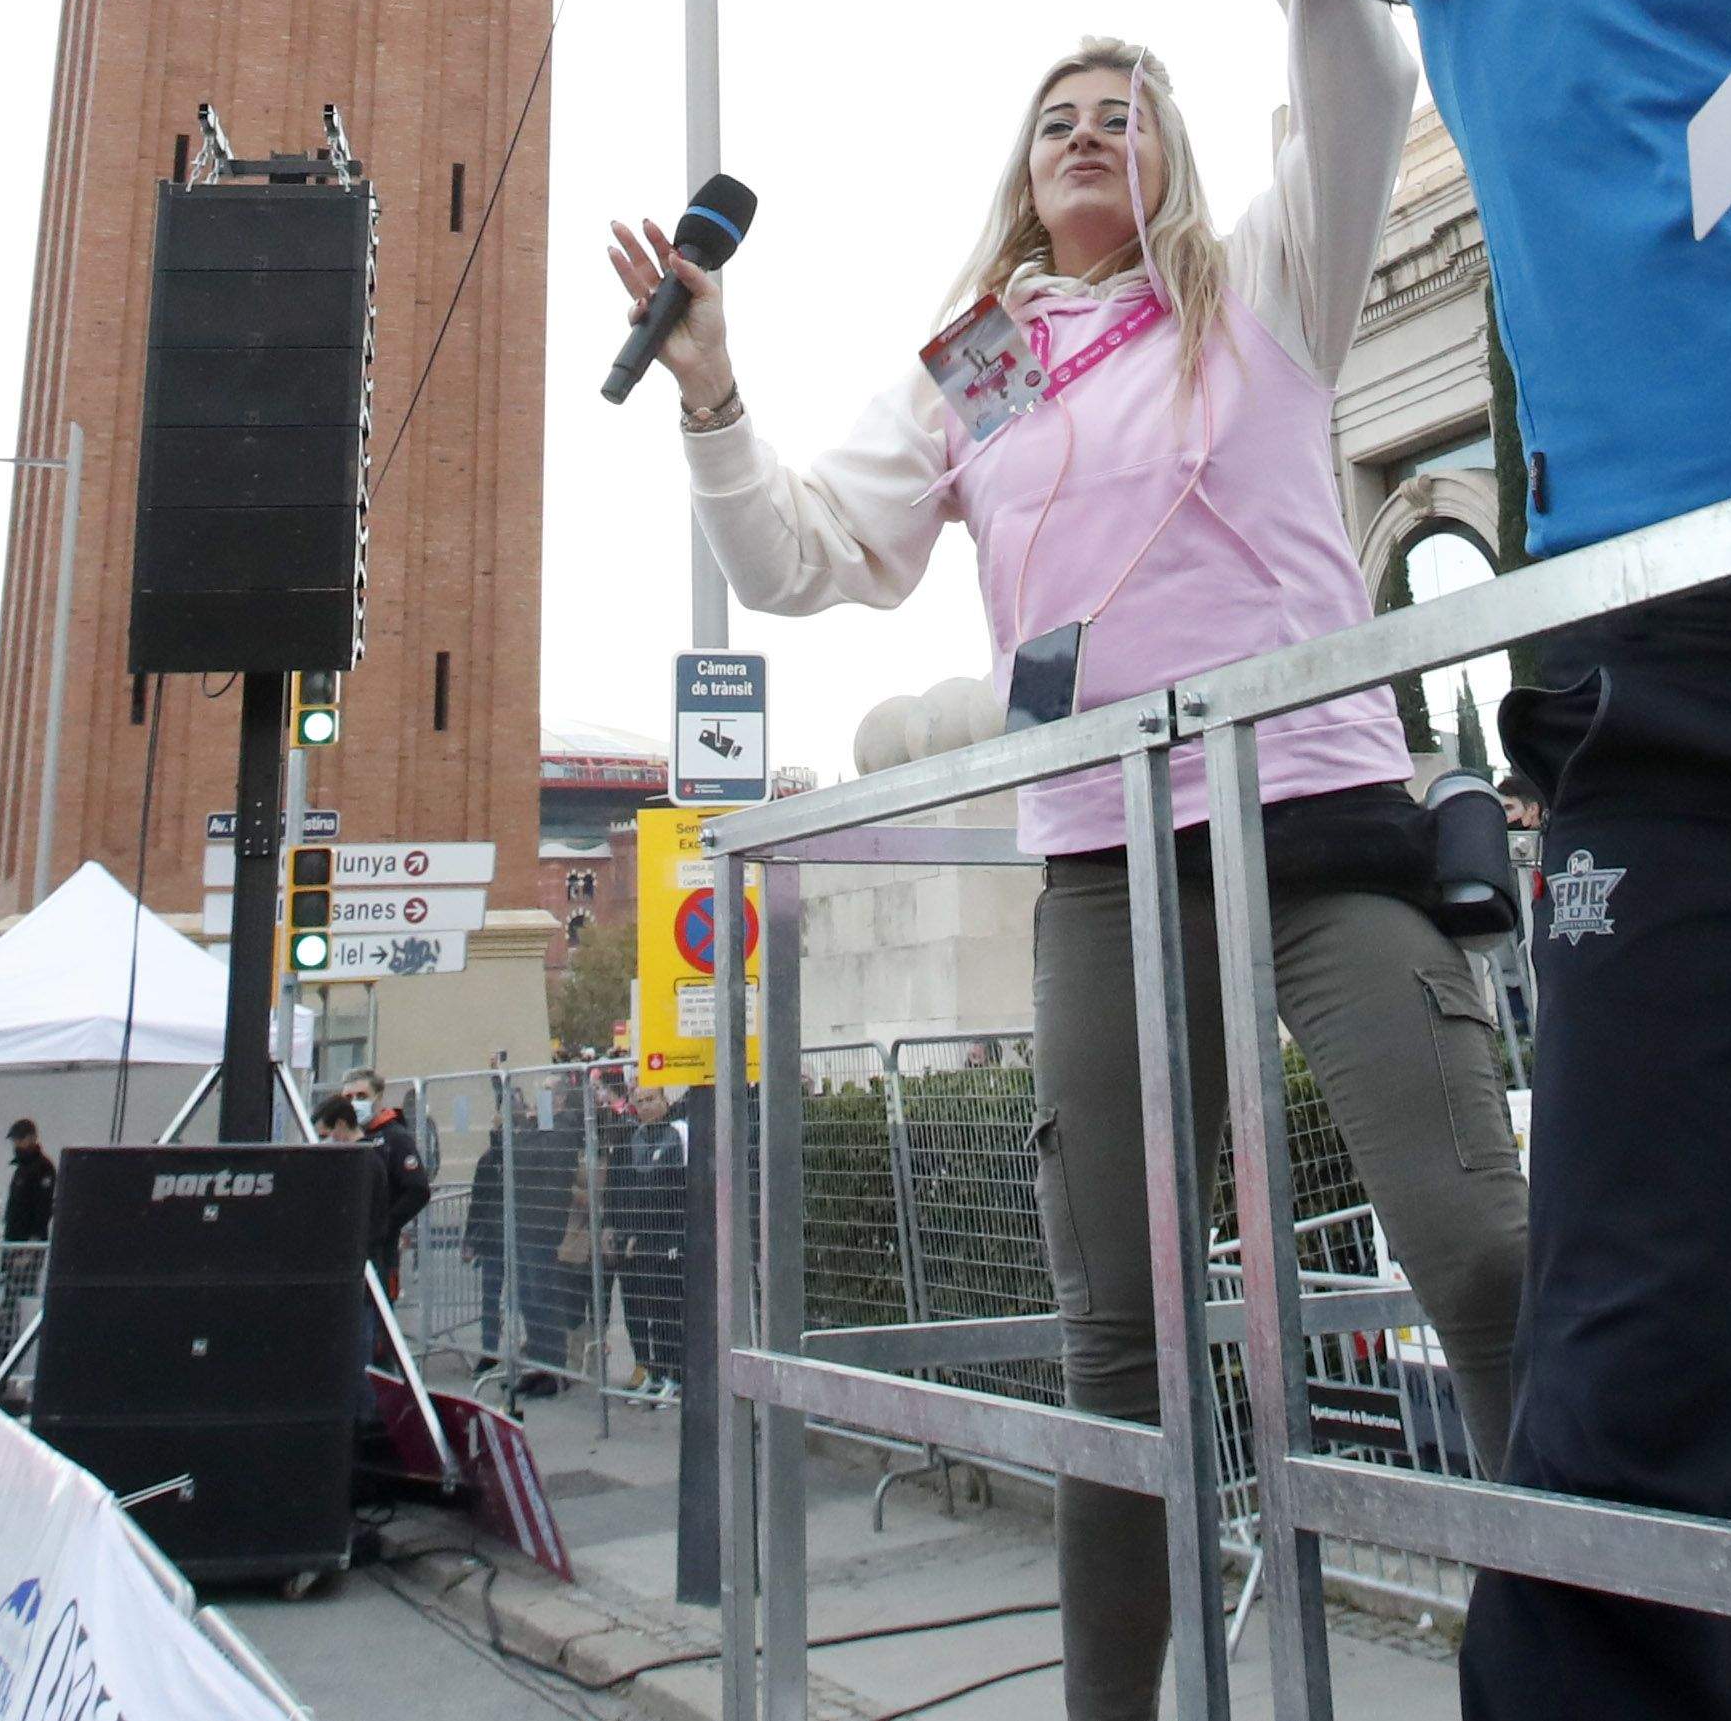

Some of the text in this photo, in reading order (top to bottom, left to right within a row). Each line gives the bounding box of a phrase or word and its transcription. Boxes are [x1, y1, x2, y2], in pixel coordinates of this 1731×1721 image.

[697, 659, 748, 677] Càmera
[691, 680, 754, 697] de trànsit
[336, 851, 397, 878] lunya
[1556, 880, 1608, 907] EPIC
[332, 902, 397, 921] sanes
